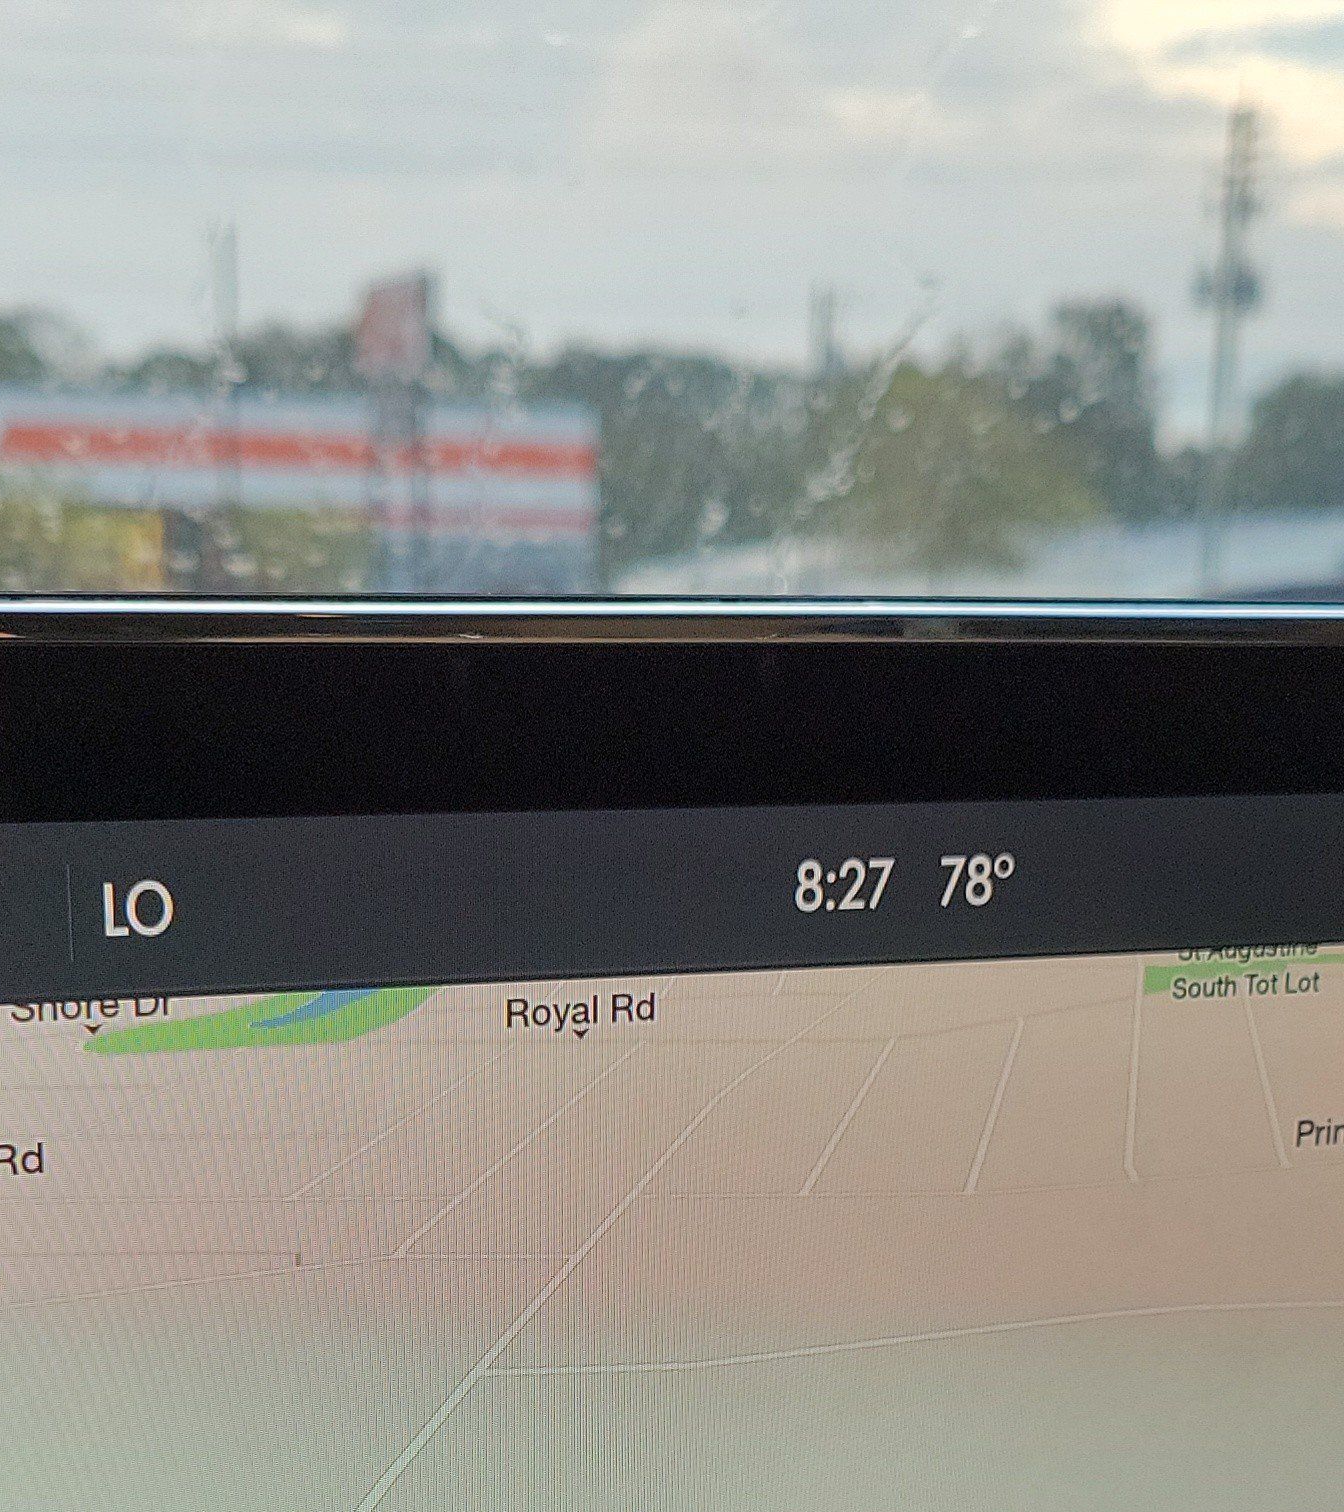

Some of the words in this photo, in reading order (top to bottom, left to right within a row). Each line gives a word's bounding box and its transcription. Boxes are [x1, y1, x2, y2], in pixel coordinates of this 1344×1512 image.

[794, 857, 896, 912] 8:27
[940, 852, 1016, 907] 78°
[103, 880, 174, 937] LO
[1172, 976, 1237, 999] South
[1243, 973, 1278, 996] Tot
[1285, 971, 1321, 995] Lot
[506, 994, 599, 1032] Royal
[611, 992, 656, 1023] Rd
